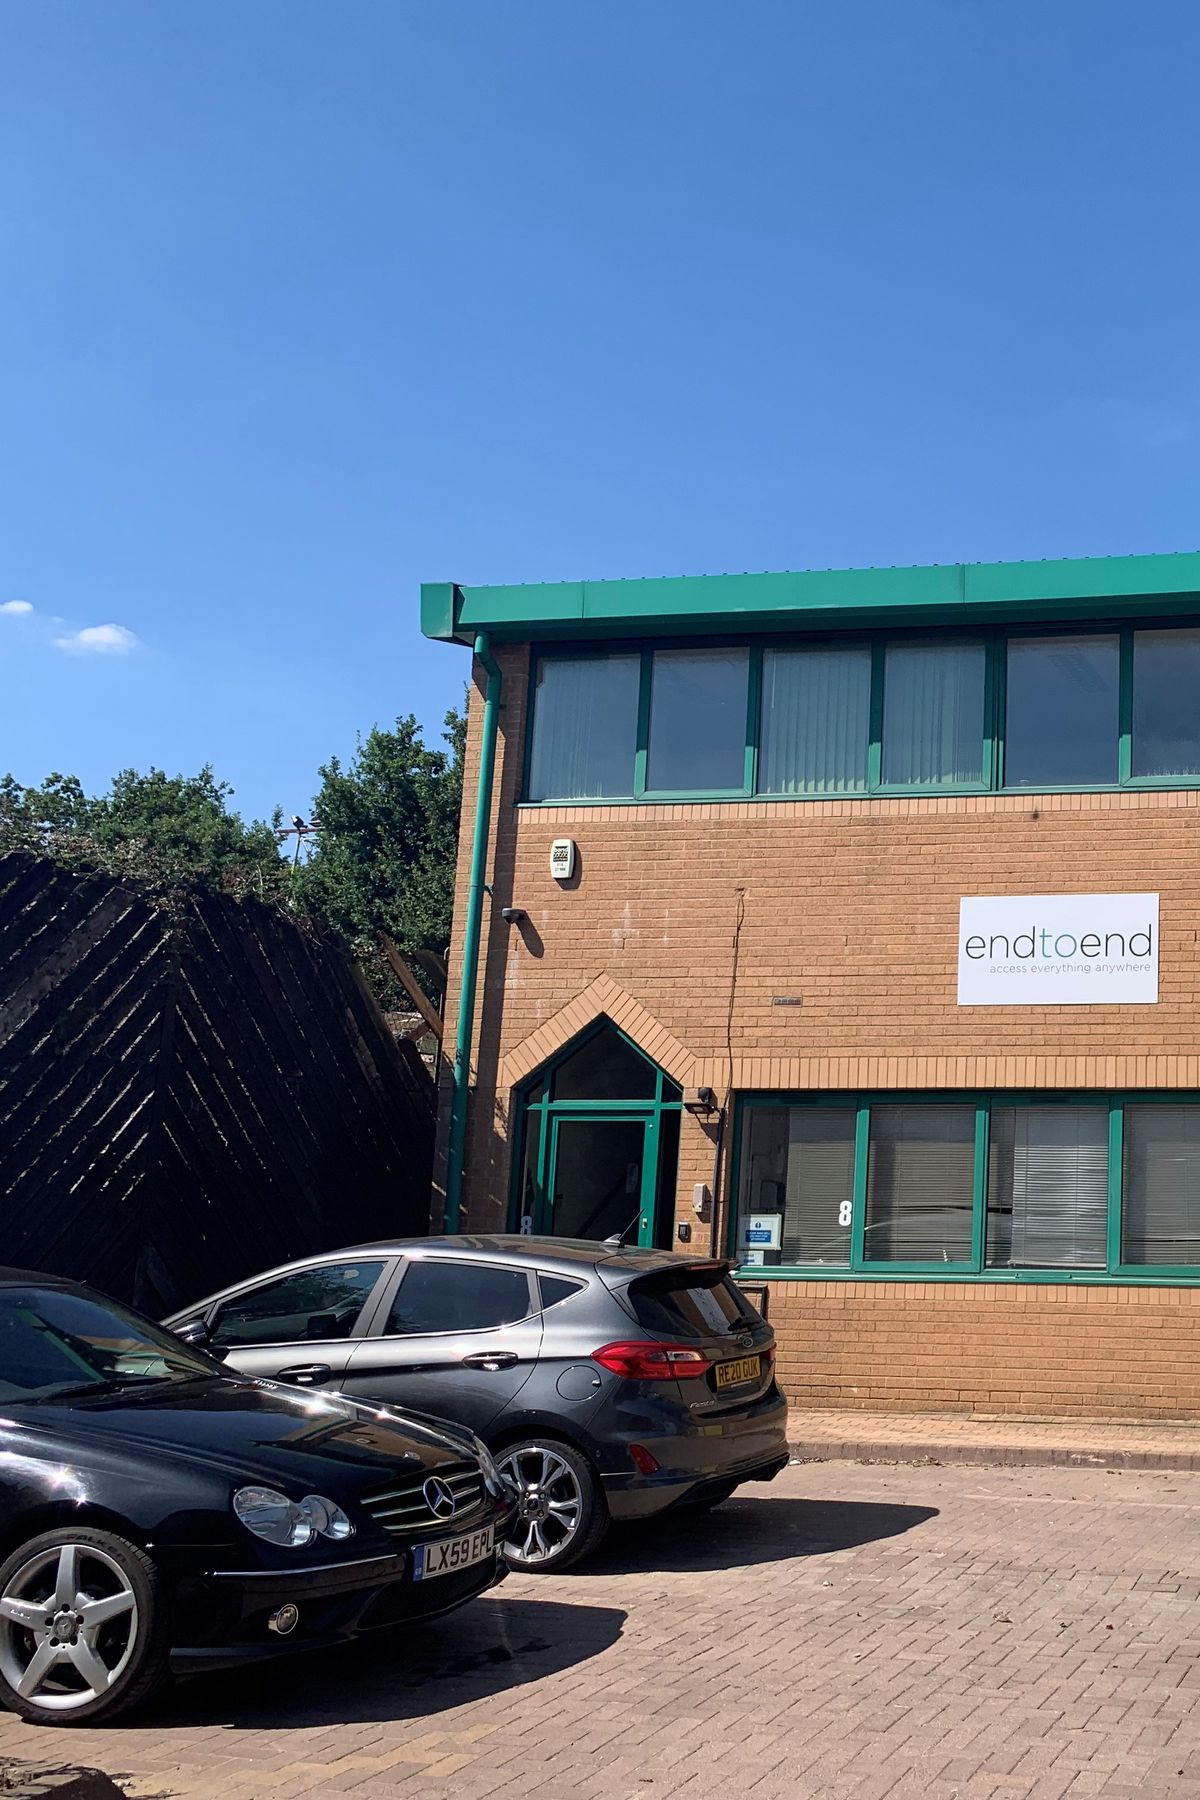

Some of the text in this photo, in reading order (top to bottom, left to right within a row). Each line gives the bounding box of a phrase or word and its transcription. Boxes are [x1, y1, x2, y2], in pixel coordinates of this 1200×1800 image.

[965, 923, 1152, 959] endtoend
[989, 962, 1151, 975] access everything anywhere
[520, 1215, 532, 1236] 8
[839, 1200, 852, 1226] 8
[718, 1357, 759, 1385] RE20 GUK
[426, 1529, 492, 1573] LX59 EPL
